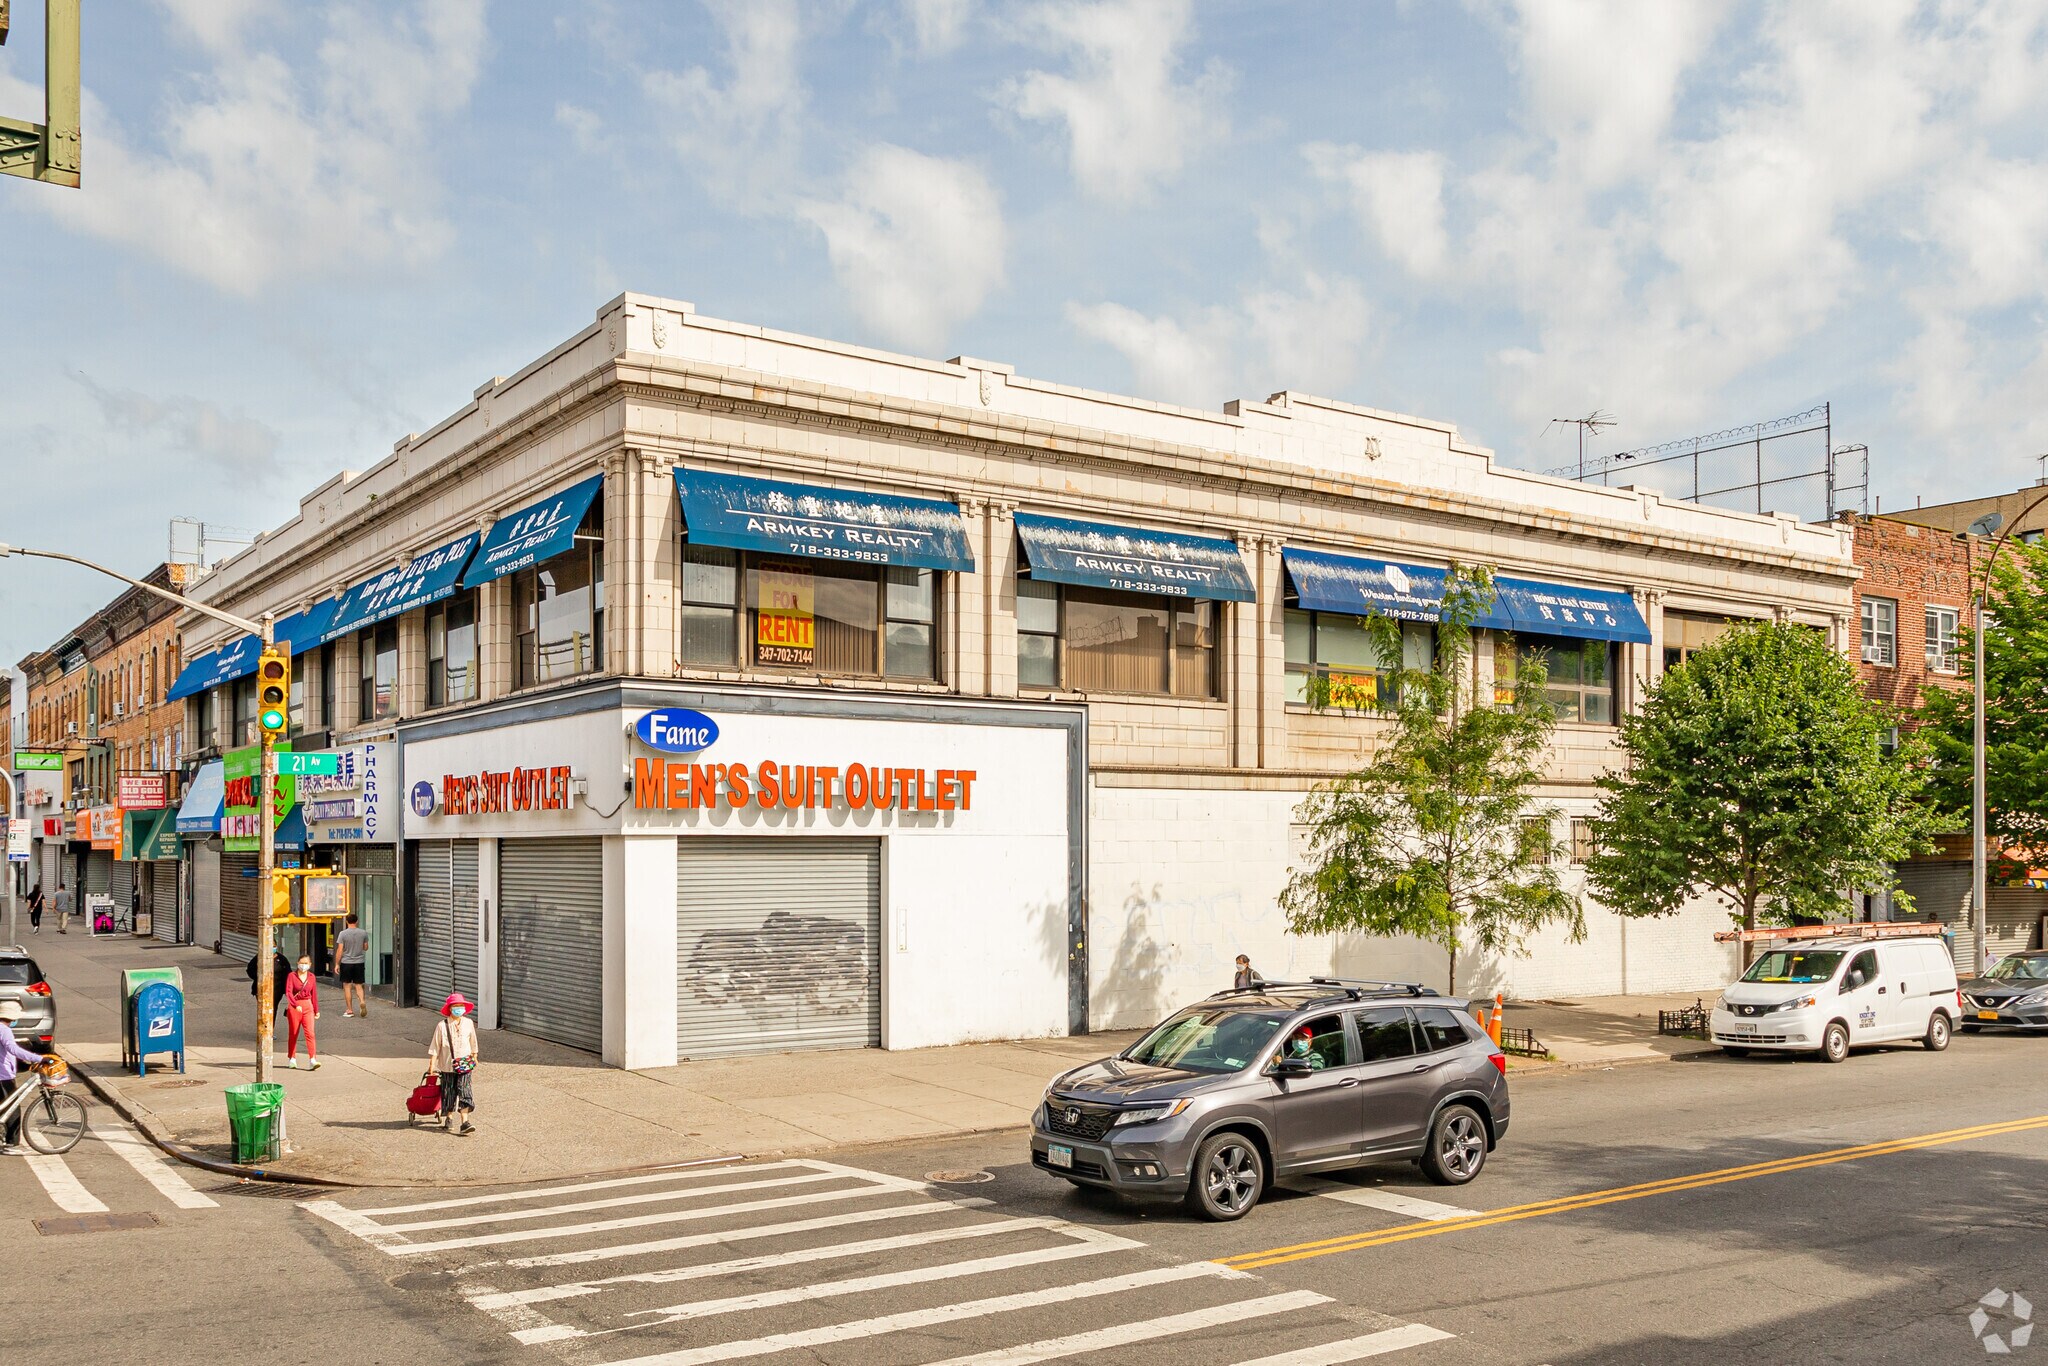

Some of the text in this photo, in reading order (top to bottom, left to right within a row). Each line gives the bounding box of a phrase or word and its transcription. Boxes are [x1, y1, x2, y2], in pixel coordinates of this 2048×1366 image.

[485, 527, 559, 565] ARMKEY REALTY
[747, 518, 922, 548] ARMKEY REALTY
[495, 553, 534, 575] 718-333-9833
[790, 543, 888, 562] 718-333-9833
[359, 582, 378, 600] Law
[444, 538, 472, 564] PLLC
[1075, 556, 1212, 582] ARMKEY REALTY
[773, 591, 799, 609] FOR
[1110, 579, 1187, 595] 718-333-9833
[1533, 594, 1609, 611] HOME LOAN CENTER
[760, 614, 812, 644] RENT
[760, 647, 812, 663] 347-702-7144
[651, 715, 709, 746] Fame
[17, 757, 59, 767] cricket
[292, 756, 321, 772] 21 Av
[364, 745, 378, 839] PHARMACY
[444, 765, 572, 815] MEN'S SUIT OUTLET
[635, 758, 977, 811] MEN'S SUIT OUTLET
